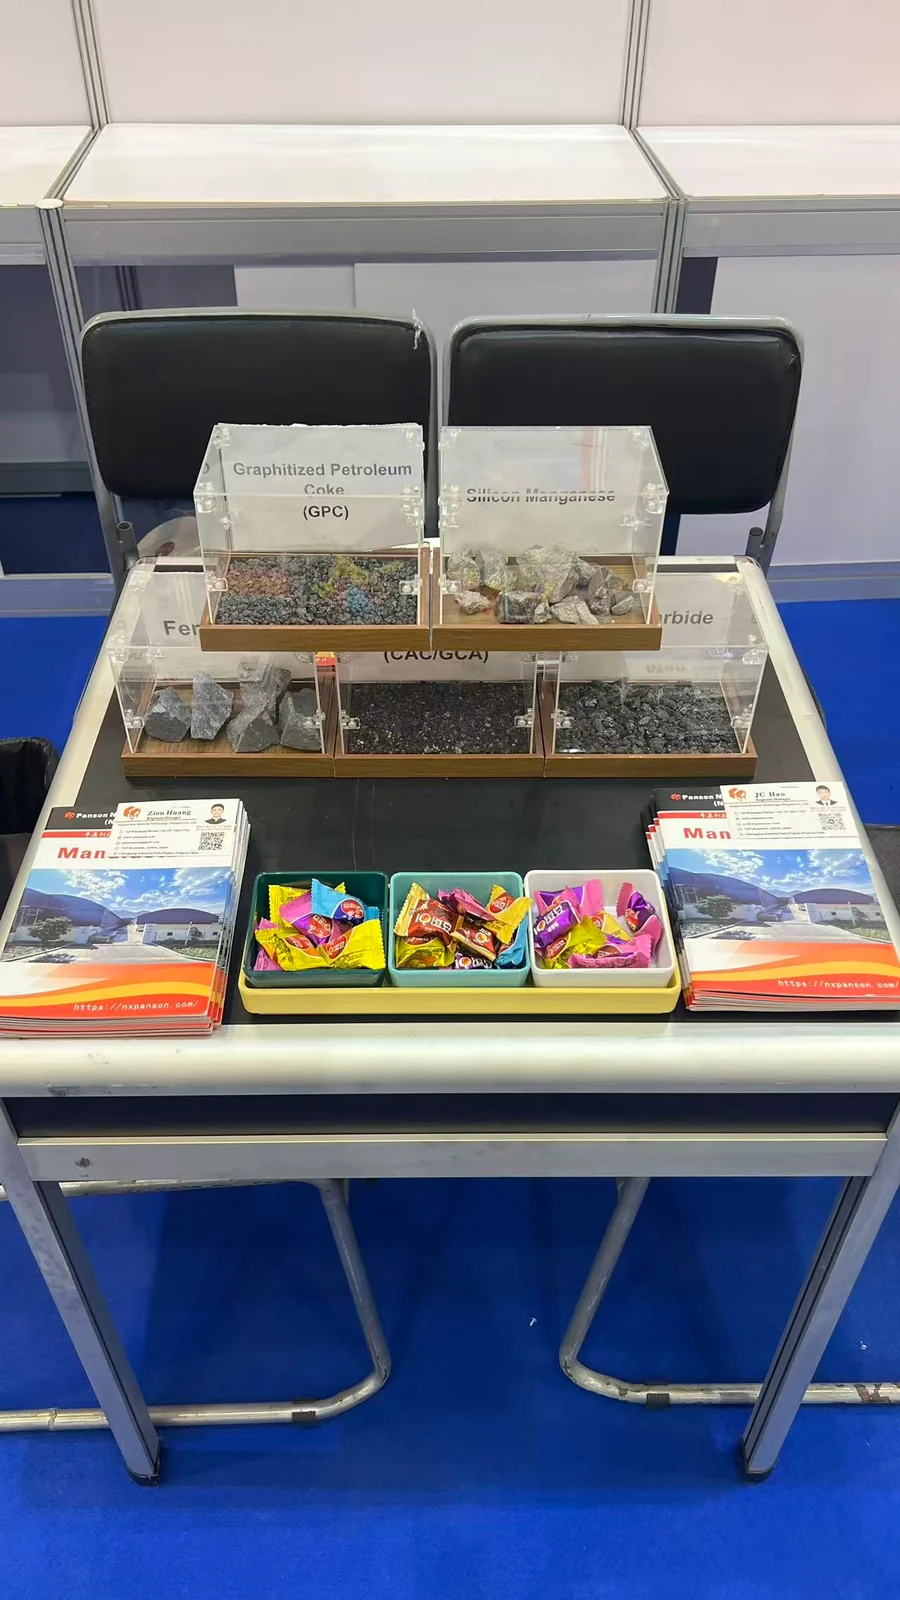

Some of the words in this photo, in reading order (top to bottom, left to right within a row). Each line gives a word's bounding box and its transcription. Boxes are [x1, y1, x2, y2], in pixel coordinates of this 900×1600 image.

[233, 462, 325, 478] Graphitized
[331, 463, 412, 476] Petroleum
[304, 483, 345, 498] Coke
[466, 488, 521, 503] Silicon
[526, 488, 615, 505] Manganese
[303, 505, 349, 521] (GPC)
[658, 610, 714, 625] rbide
[383, 651, 489, 664] (CAC/GCA)
